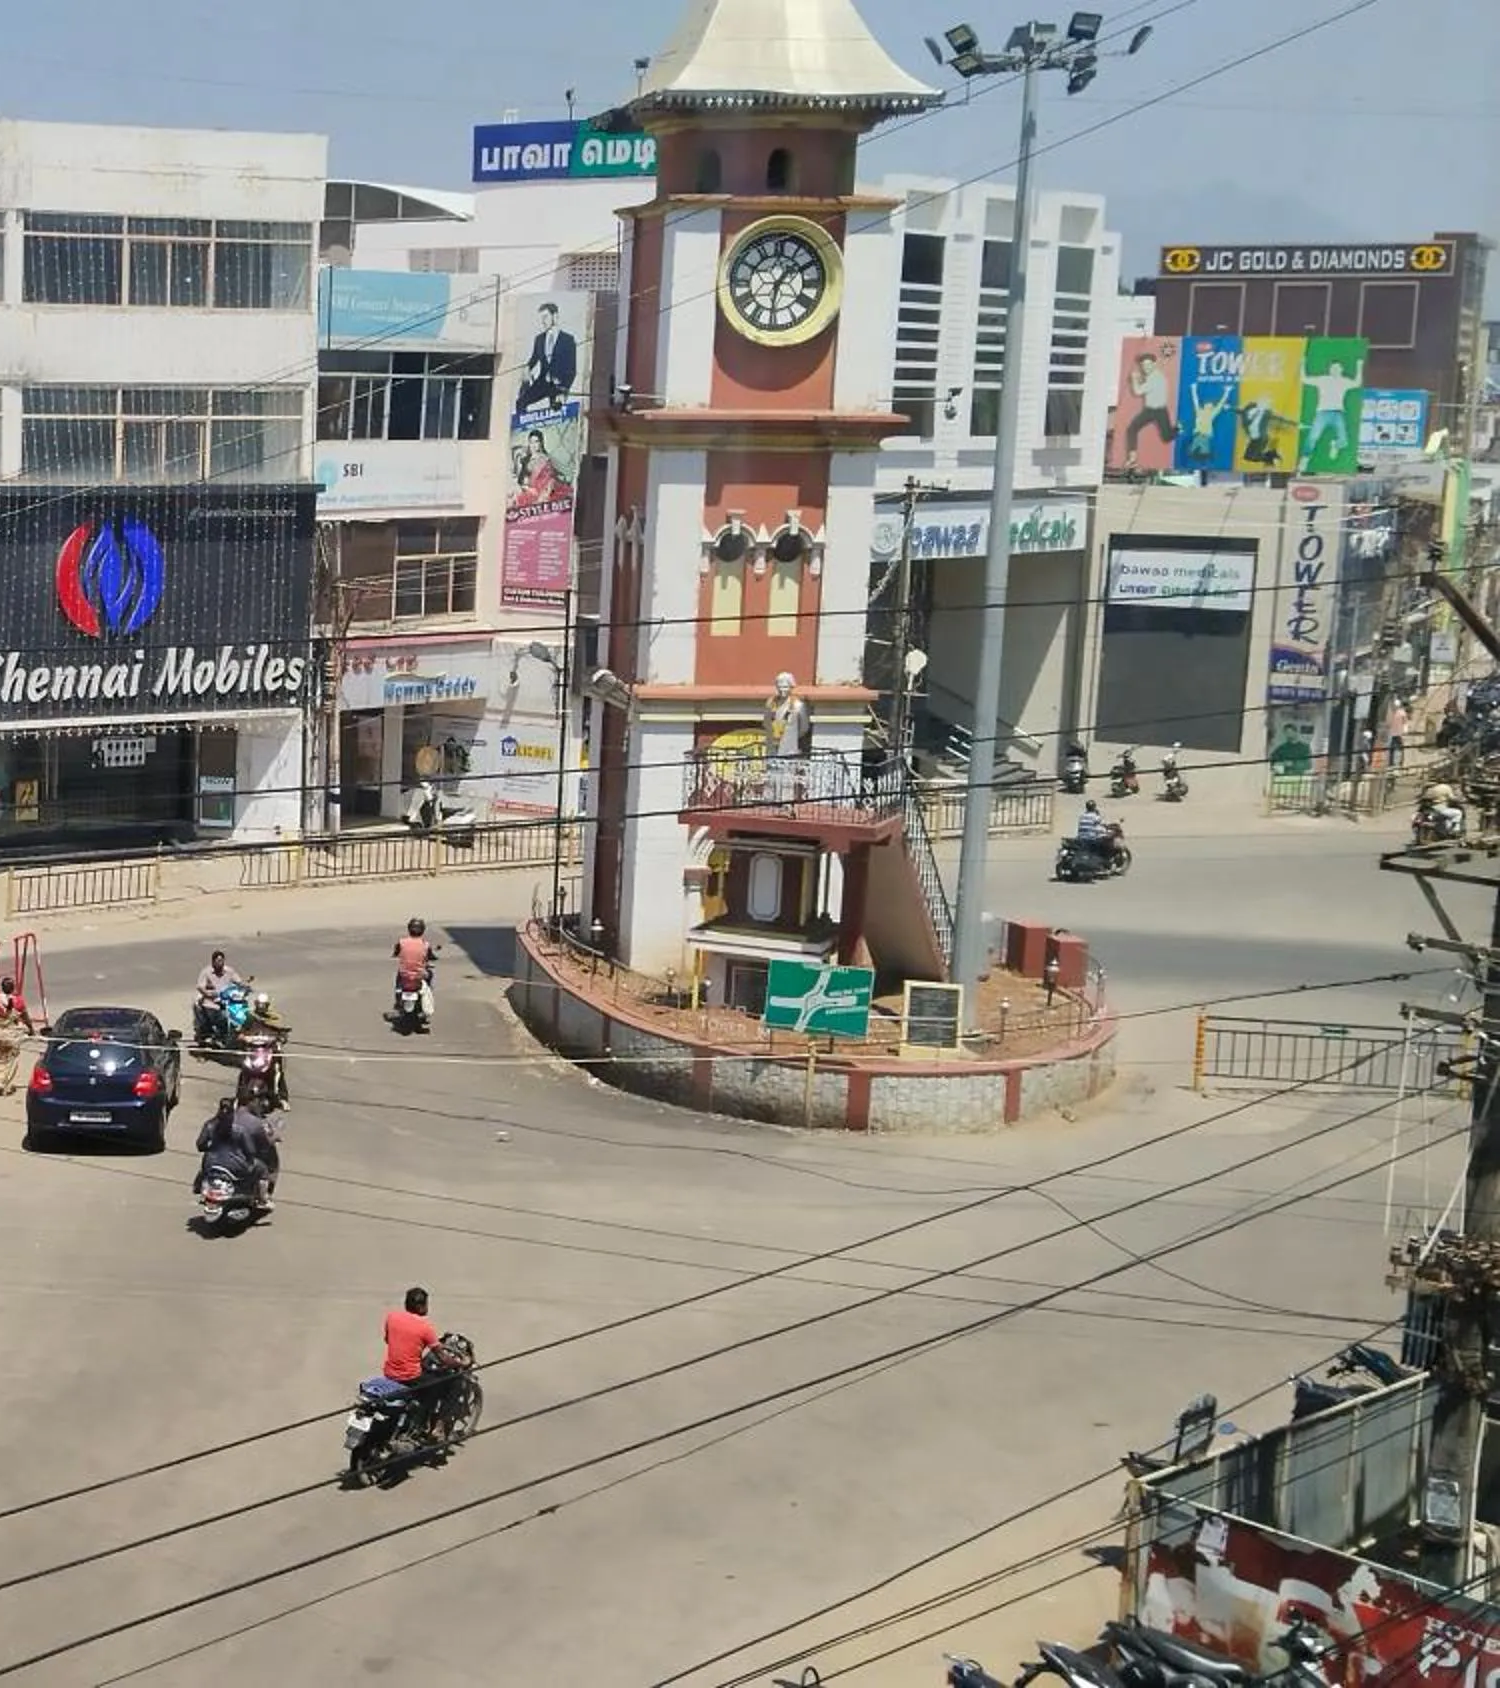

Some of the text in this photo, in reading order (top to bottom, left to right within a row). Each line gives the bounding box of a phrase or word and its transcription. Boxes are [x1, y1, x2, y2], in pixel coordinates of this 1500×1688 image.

[481, 143, 572, 173] பாவா
[1206, 249, 1405, 272] JC GOLD & DIAMONDS
[342, 462, 364, 478] SBI
[1008, 506, 1077, 547] edicals
[153, 644, 306, 698] Mobiles
